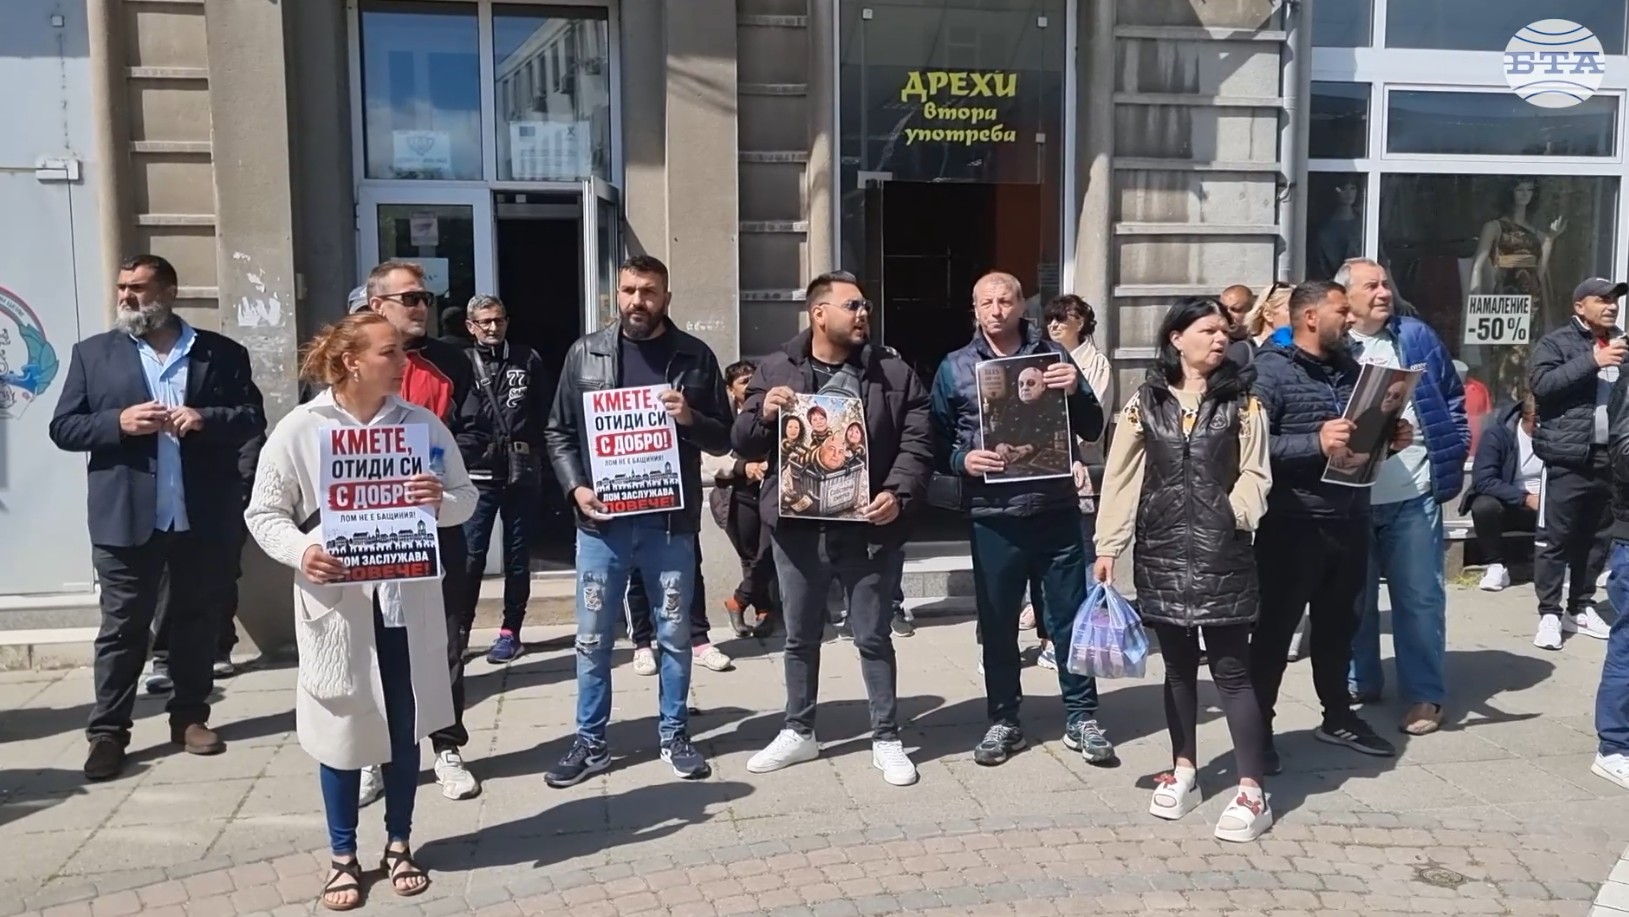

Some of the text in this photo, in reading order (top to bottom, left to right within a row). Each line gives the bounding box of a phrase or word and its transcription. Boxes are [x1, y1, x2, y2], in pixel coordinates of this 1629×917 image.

[901, 70, 1017, 103] ДРЕХИ
[923, 101, 998, 124] втора
[904, 124, 1016, 147] употреба
[1469, 297, 1529, 315] НАМАЛЕНИЕ
[593, 388, 658, 413] КМЕТЕ,
[595, 411, 667, 431] ОТИДИ СИ
[331, 427, 413, 456] КМЕТЕ,
[600, 431, 668, 455] С ДОБРО!
[331, 457, 423, 480] ОТИДИ СИ
[336, 485, 349, 507] С
[603, 487, 675, 503] ЛОМ ЗАСЛУЖАВА
[340, 511, 416, 523] ЛОМ НЕ Е БАЩИНИЯ!
[361, 551, 429, 566] ЗАСЛУЖАВА
